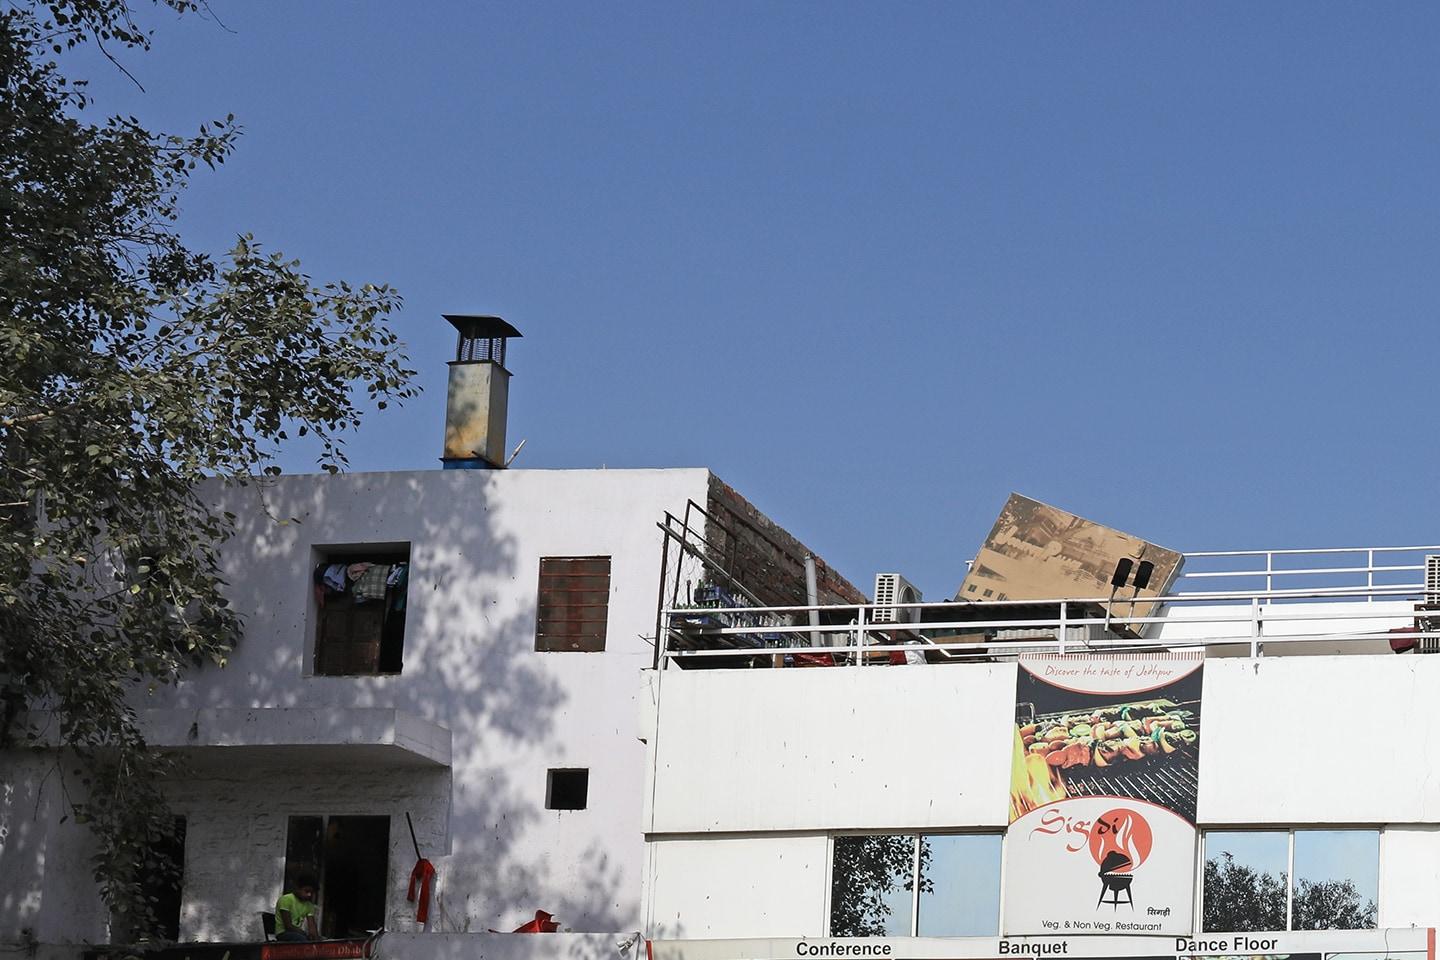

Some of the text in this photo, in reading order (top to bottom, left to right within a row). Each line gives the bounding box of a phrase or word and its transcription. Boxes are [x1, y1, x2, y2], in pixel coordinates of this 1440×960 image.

[1045, 664, 1173, 680] Discover the taste of Jodhpur
[1042, 920, 1061, 930] Veg.
[1073, 921, 1091, 929] Non
[1093, 921, 1113, 931] Veg.
[1115, 921, 1162, 931] Restaurant
[796, 941, 892, 956] Conference
[999, 940, 1068, 957] Banquet
[1176, 936, 1278, 952] Dance Floor
